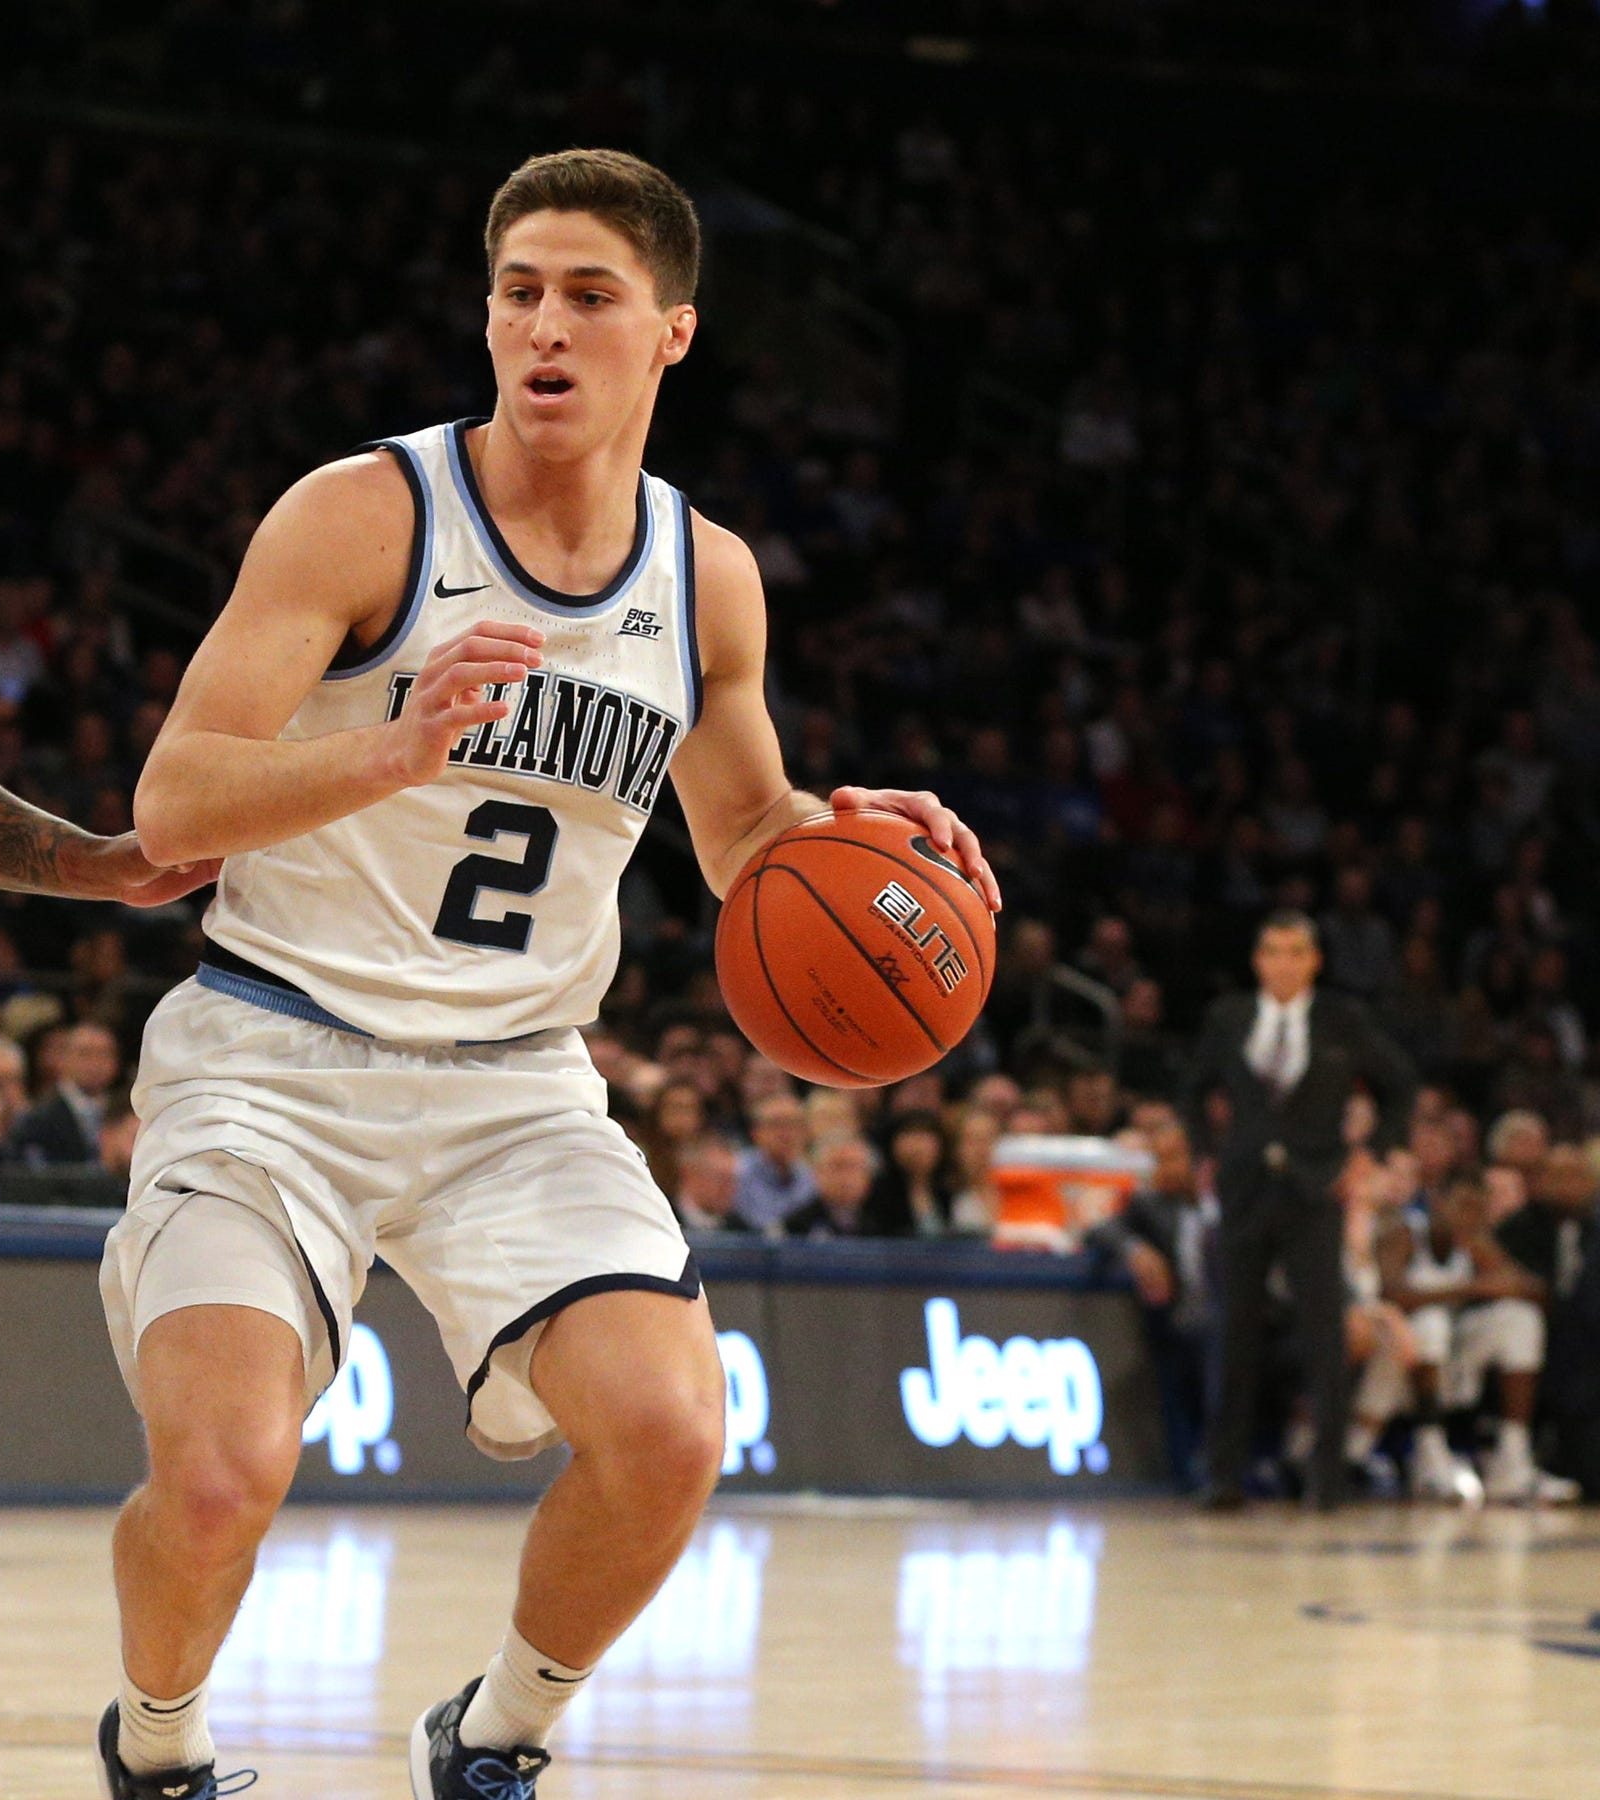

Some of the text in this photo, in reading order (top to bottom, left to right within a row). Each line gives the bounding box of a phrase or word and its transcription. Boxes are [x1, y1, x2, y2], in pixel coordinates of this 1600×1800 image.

[621, 619, 663, 636] EAST
[626, 607, 657, 624] BIG
[432, 799, 560, 955] 2
[872, 881, 968, 993] ELITE
